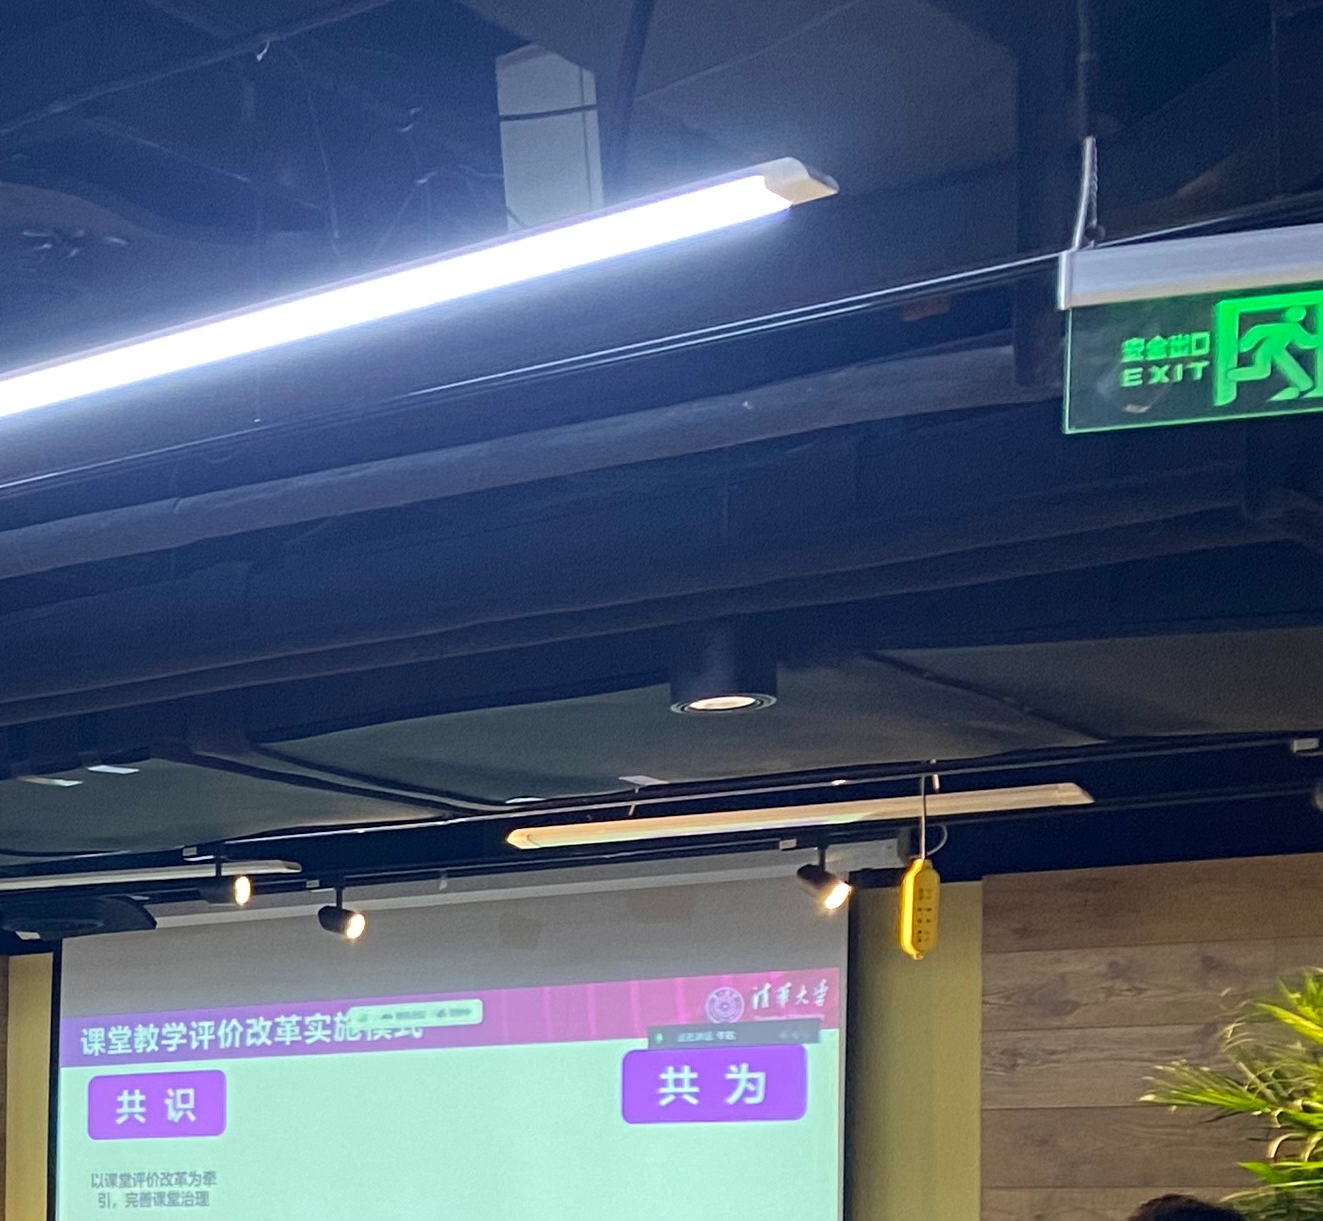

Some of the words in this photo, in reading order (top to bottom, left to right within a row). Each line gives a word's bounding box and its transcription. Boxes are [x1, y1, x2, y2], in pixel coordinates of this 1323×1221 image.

[1121, 331, 1210, 363] 安全出口
[1121, 361, 1210, 387] EXIT
